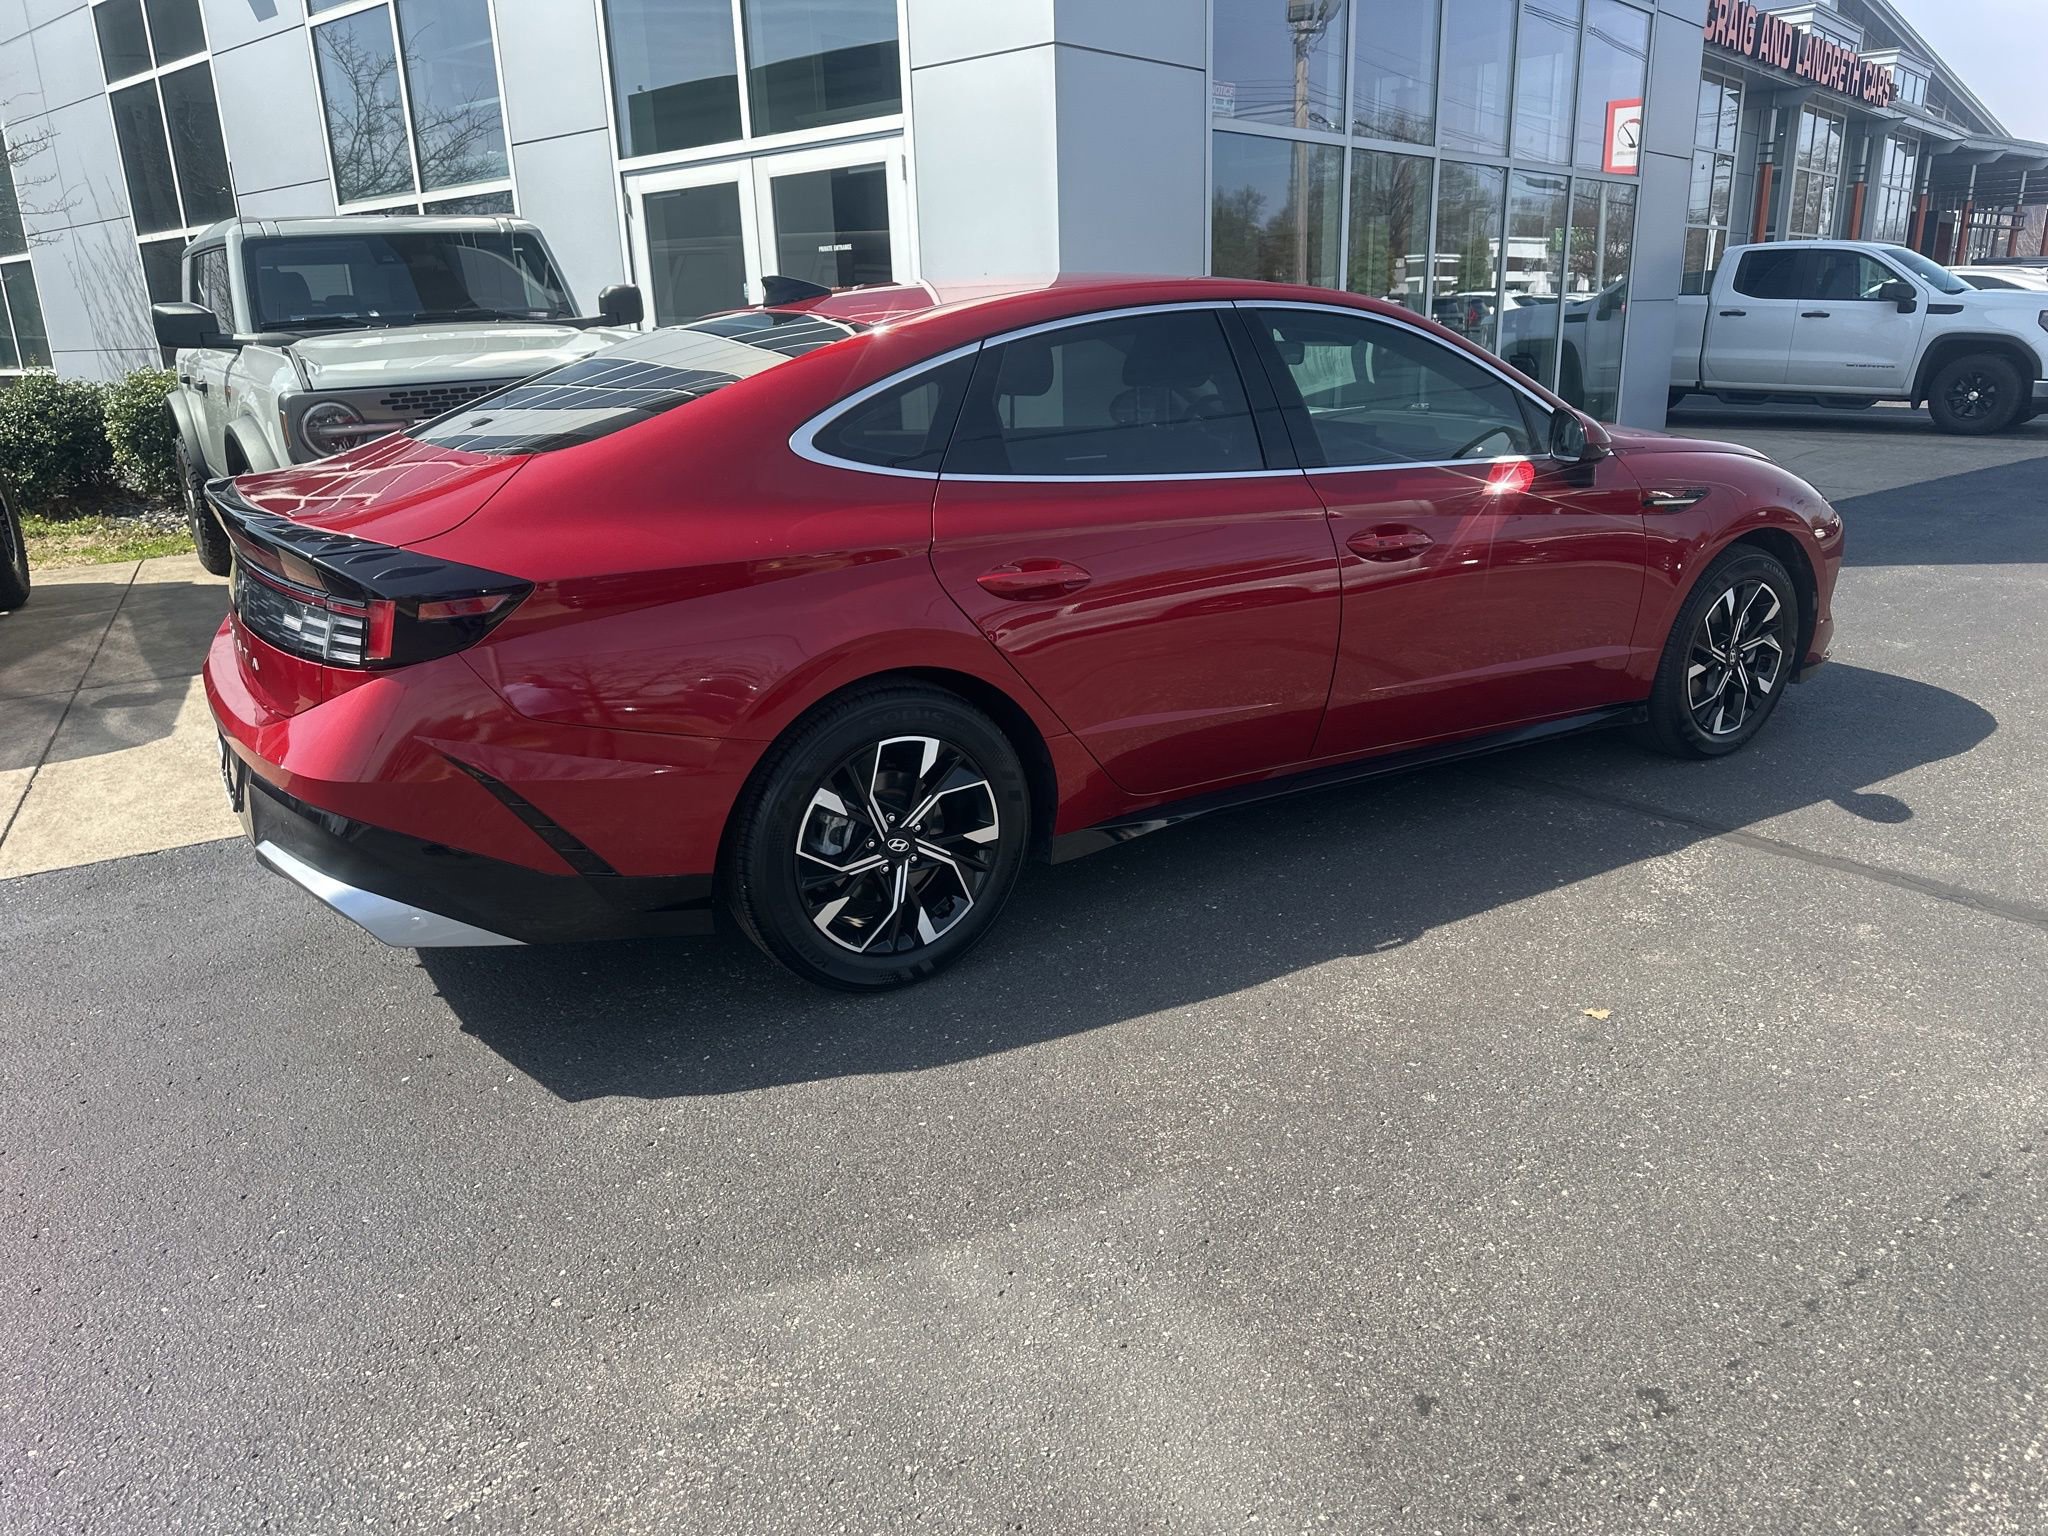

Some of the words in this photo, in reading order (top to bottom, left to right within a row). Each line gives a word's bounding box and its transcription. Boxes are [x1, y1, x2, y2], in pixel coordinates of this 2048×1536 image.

[1703, 0, 1756, 55] CRAIG
[1759, 13, 1792, 70] AND
[1795, 29, 1861, 97] LANDRETH
[1863, 60, 1892, 107] CARS
